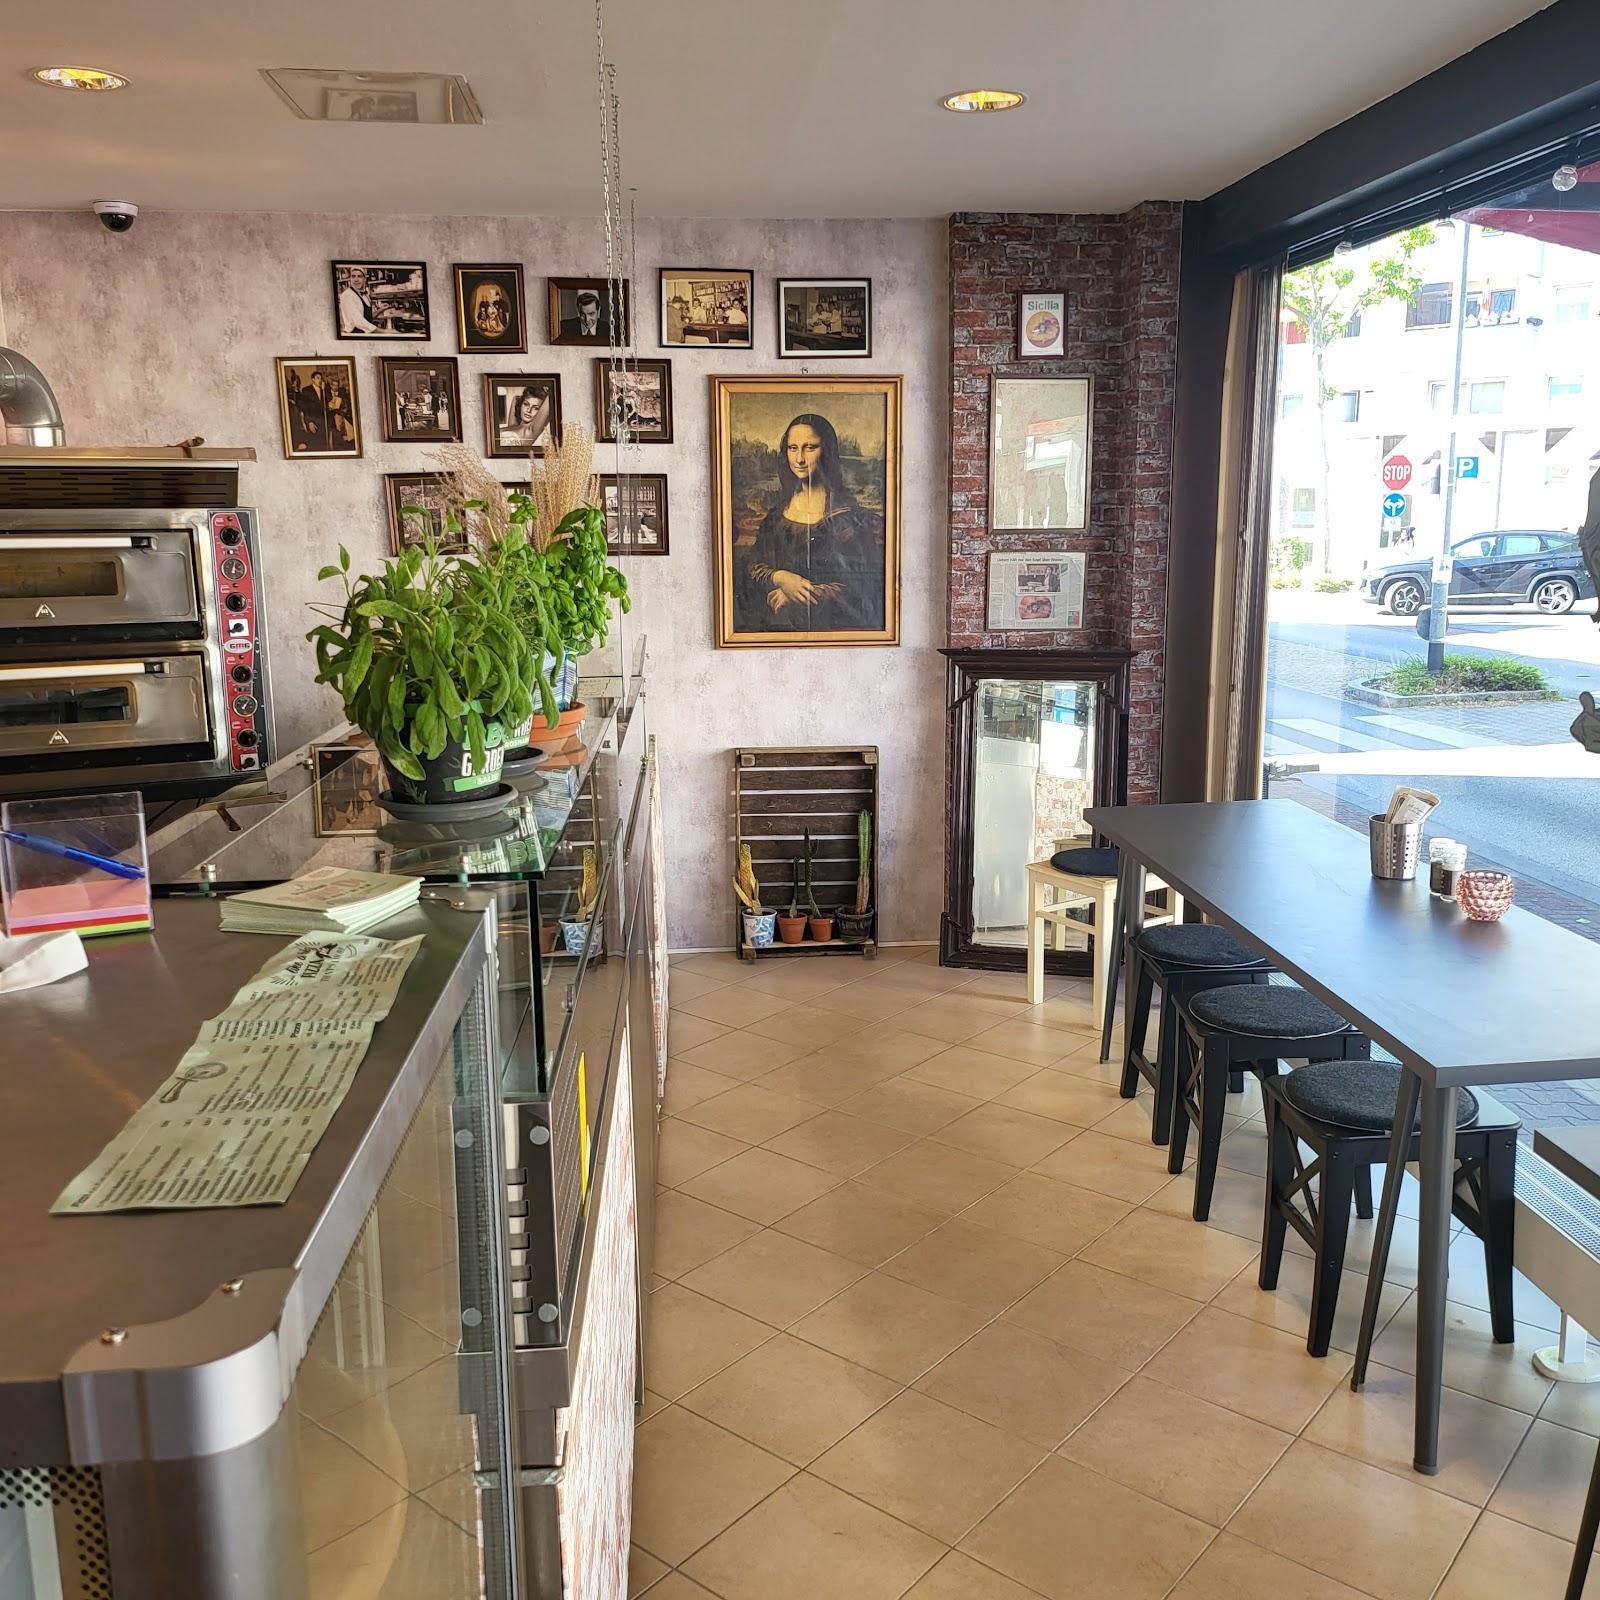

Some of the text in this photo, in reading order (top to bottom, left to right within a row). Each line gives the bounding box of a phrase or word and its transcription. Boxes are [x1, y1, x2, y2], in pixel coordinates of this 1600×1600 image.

[1383, 464, 1411, 480] STOP
[1458, 458, 1474, 477] P
[300, 959, 324, 978] PIZZA
